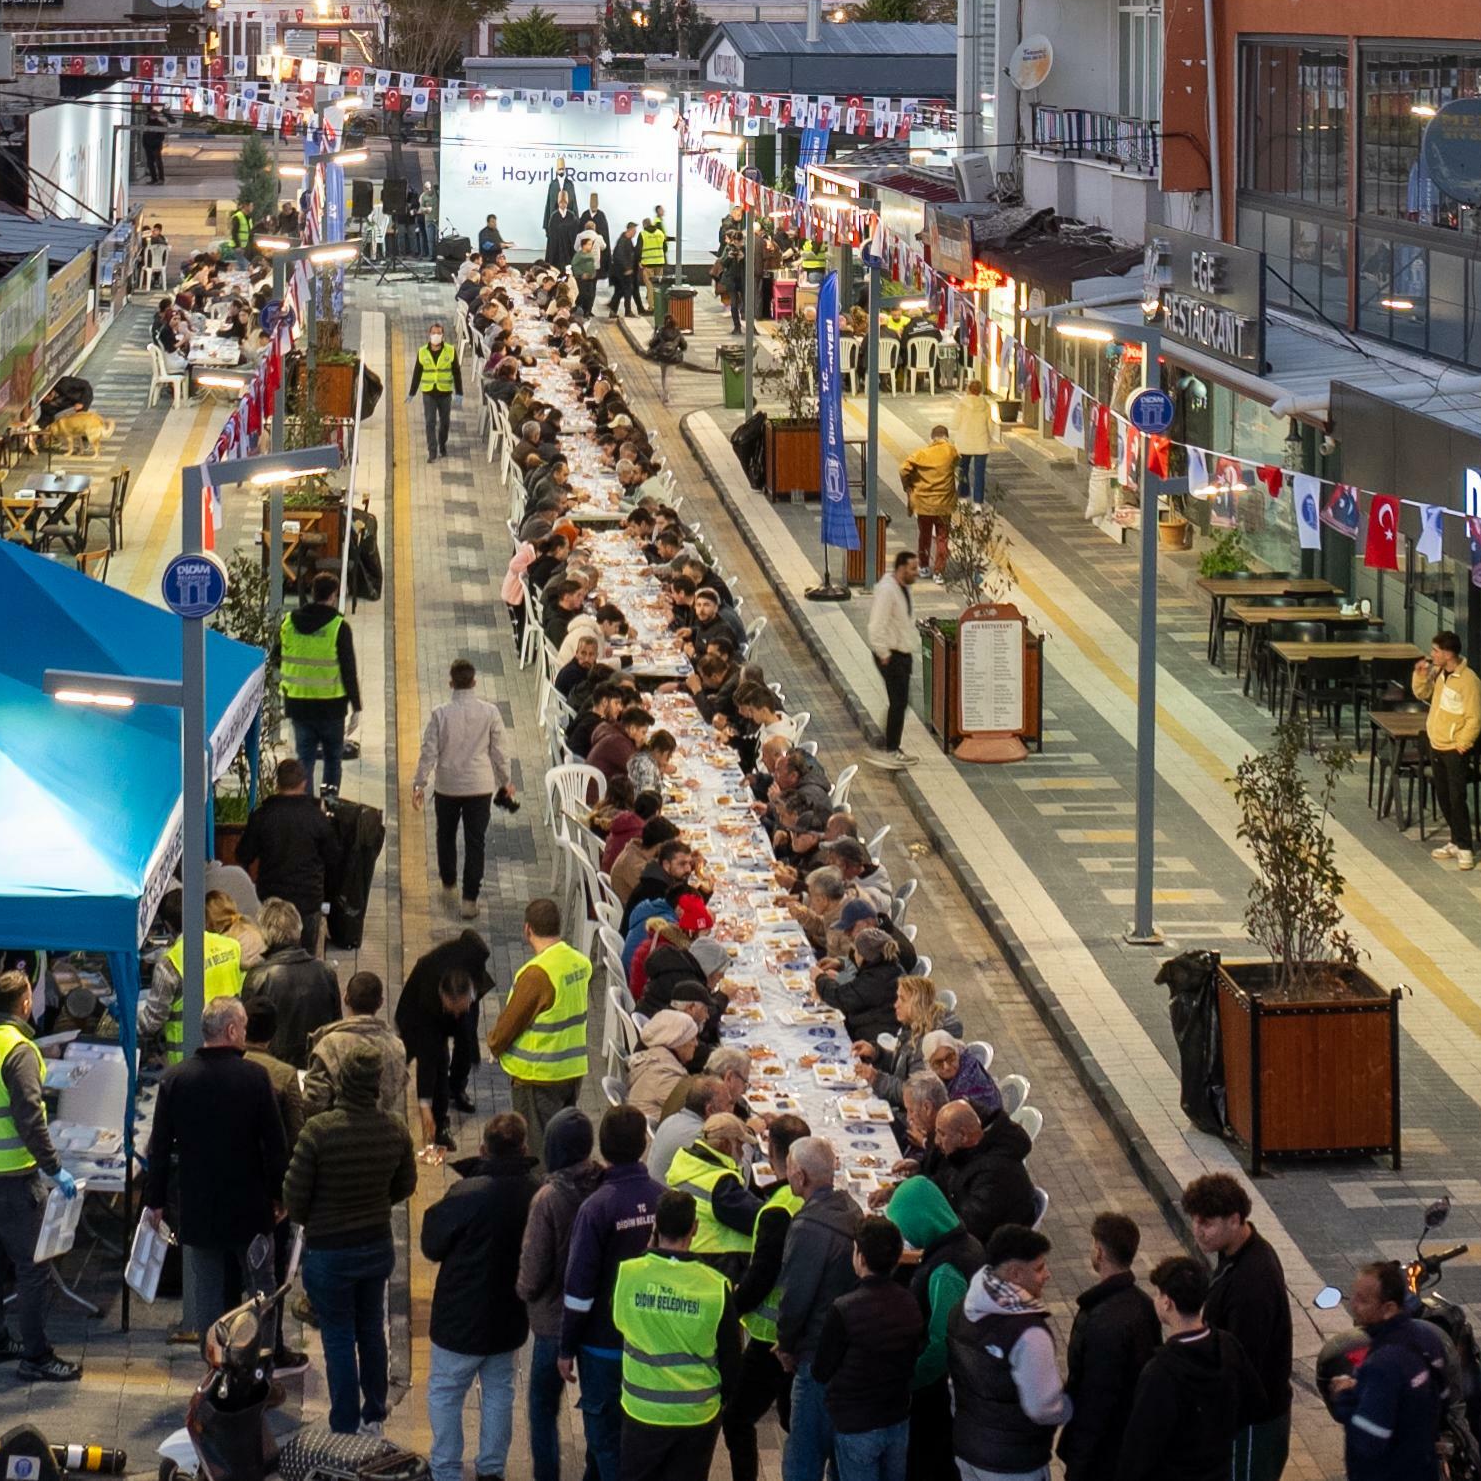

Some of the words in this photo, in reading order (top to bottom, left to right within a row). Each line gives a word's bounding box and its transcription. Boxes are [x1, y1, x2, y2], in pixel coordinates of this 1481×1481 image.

[502, 167, 557, 185] Hayırl
[565, 167, 675, 184] Ramazanlar
[1191, 250, 1215, 294] EGE
[1163, 291, 1245, 358] RESTAURANT
